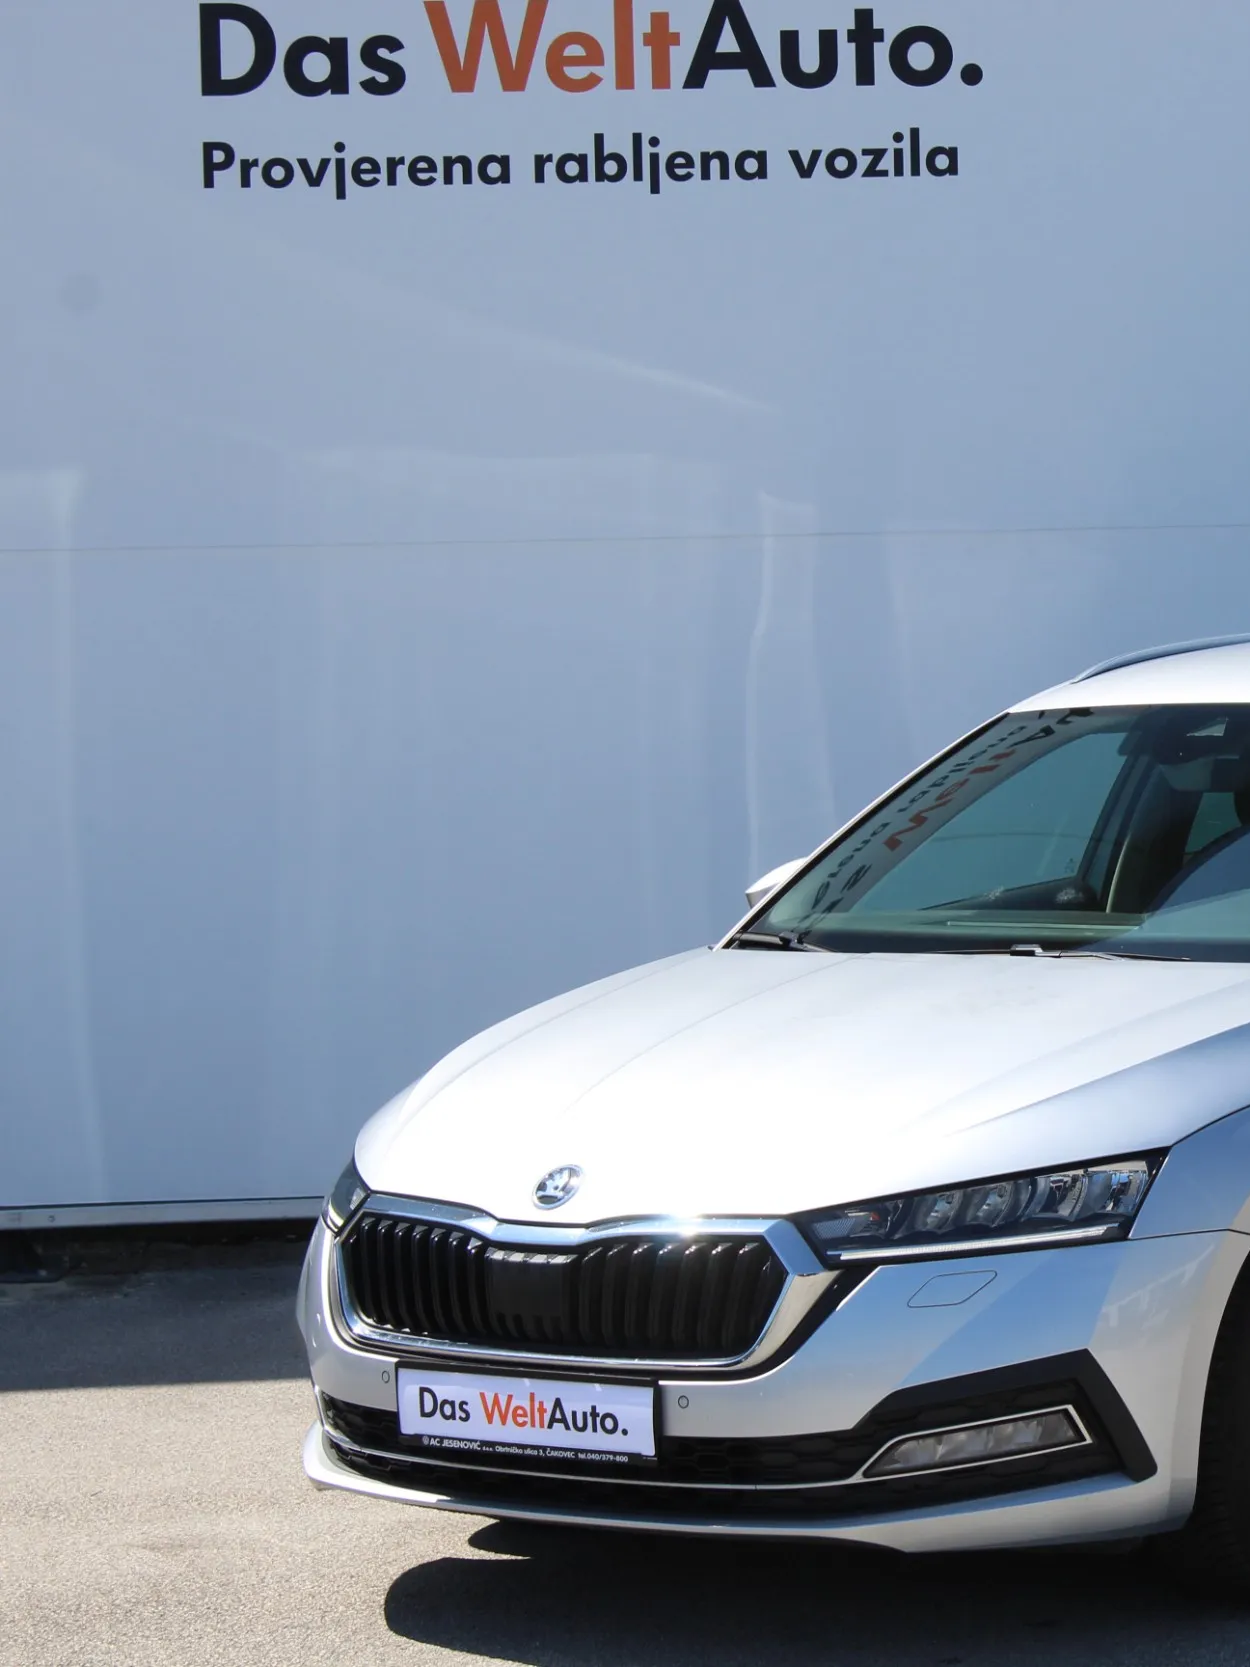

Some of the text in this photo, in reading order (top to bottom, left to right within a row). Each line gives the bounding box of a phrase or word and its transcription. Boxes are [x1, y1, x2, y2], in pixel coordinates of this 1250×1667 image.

[199, 0, 984, 97] Das WeltAuto.
[202, 127, 959, 200] Provjerena rabljena vozila
[418, 1386, 629, 1437] Das WeltAuto.
[430, 1437, 441, 1446] AC
[442, 1439, 481, 1450] JESENOVIĆ
[546, 1447, 575, 1459] ČAKOVEC
